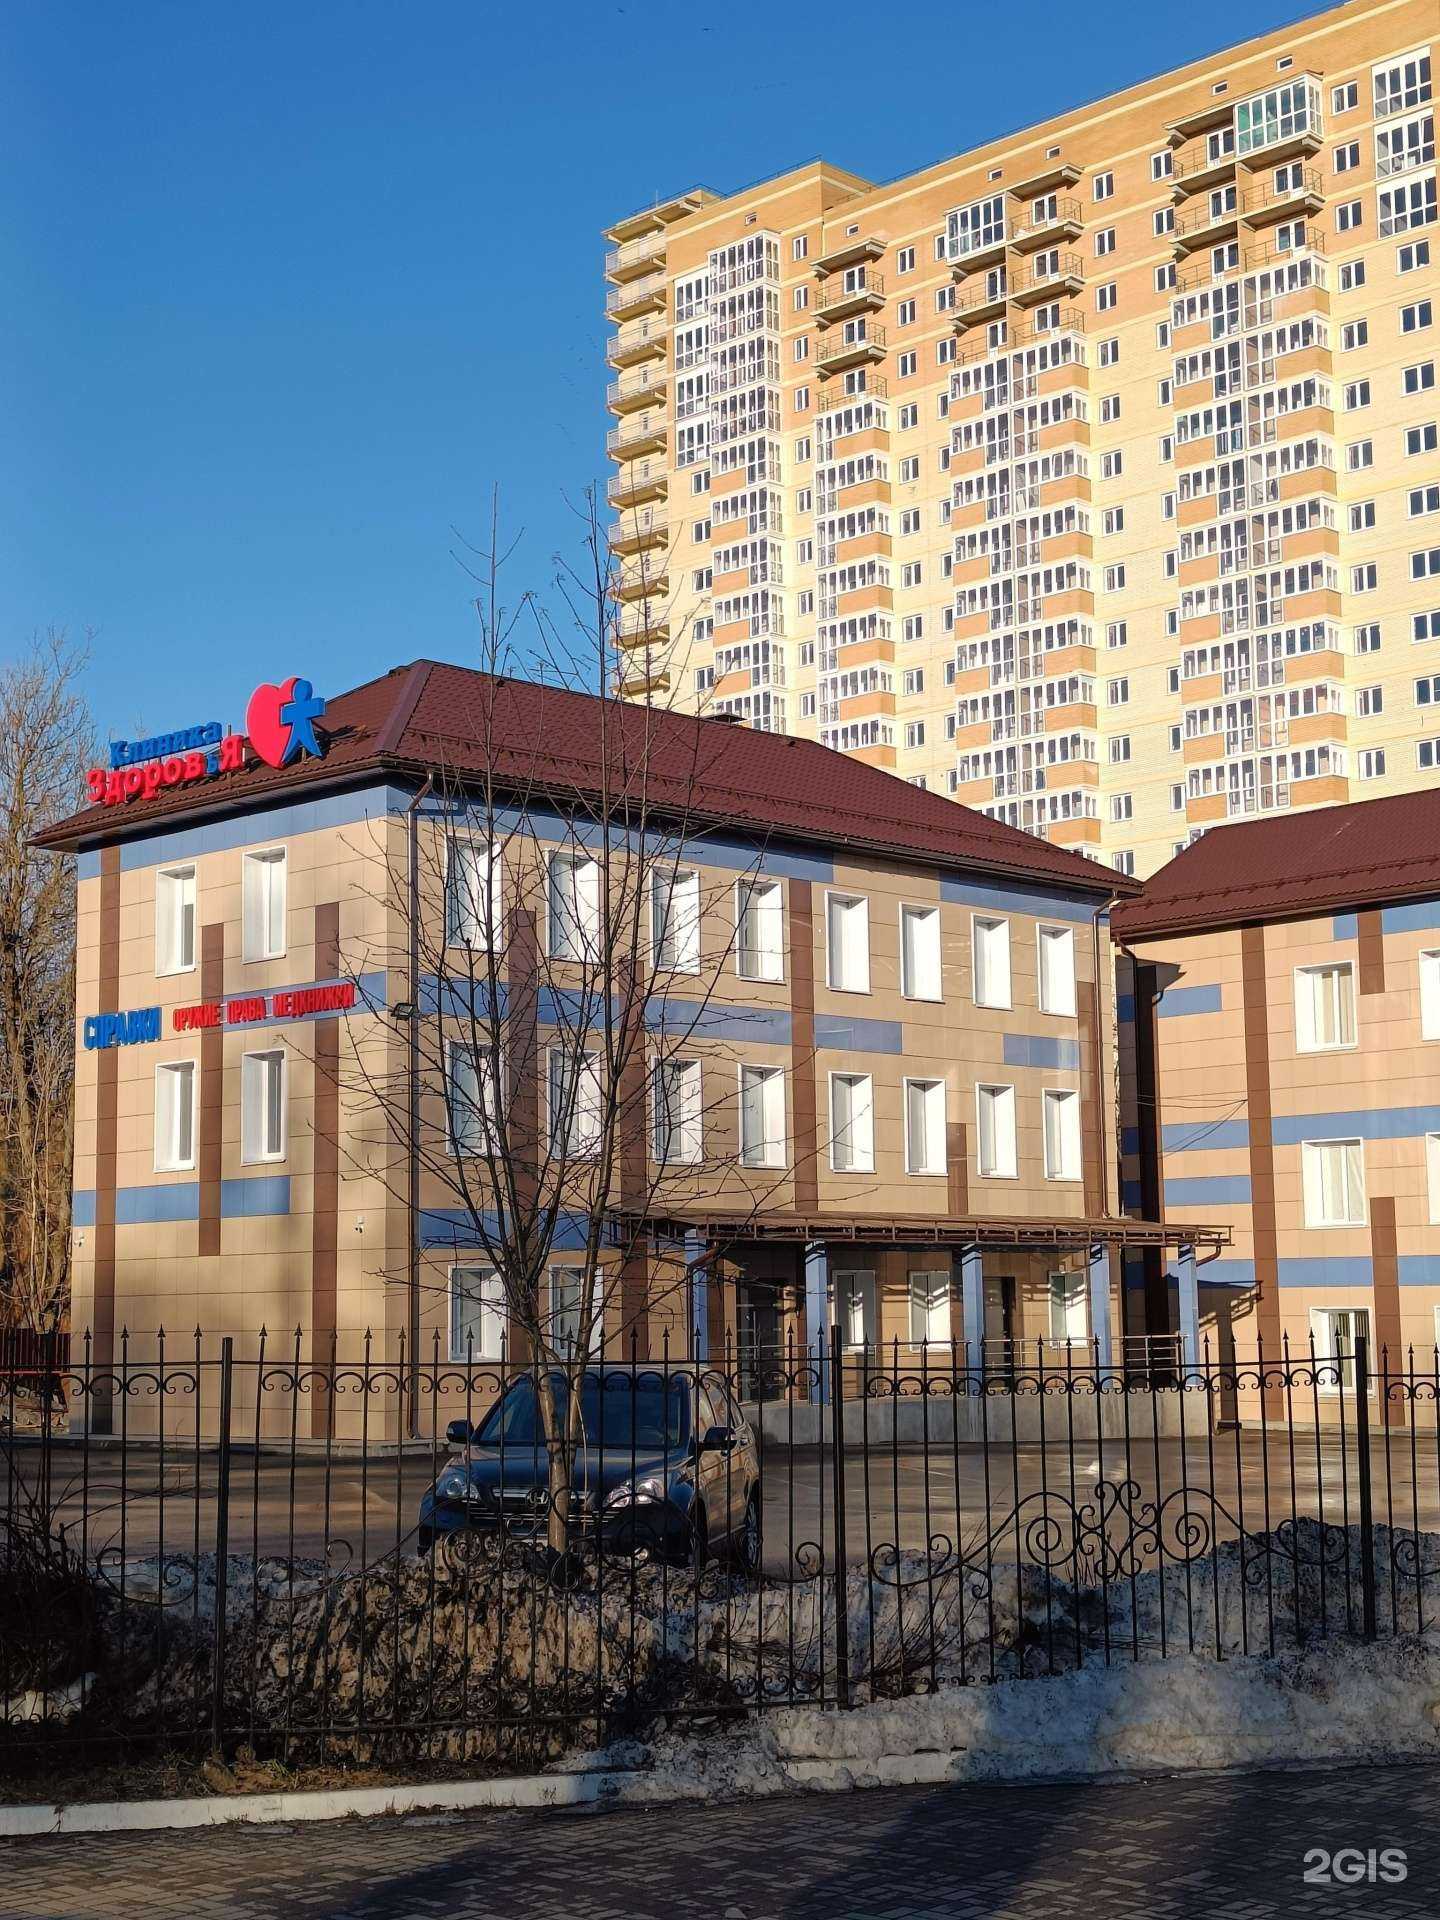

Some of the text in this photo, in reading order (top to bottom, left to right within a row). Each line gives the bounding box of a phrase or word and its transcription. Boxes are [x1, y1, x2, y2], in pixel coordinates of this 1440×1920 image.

[110, 722, 223, 768] Клиника
[84, 1006, 163, 1050] СПРАВКИ
[173, 1003, 222, 1032] ОРУЖИЕ
[227, 996, 267, 1024] ПРАВА
